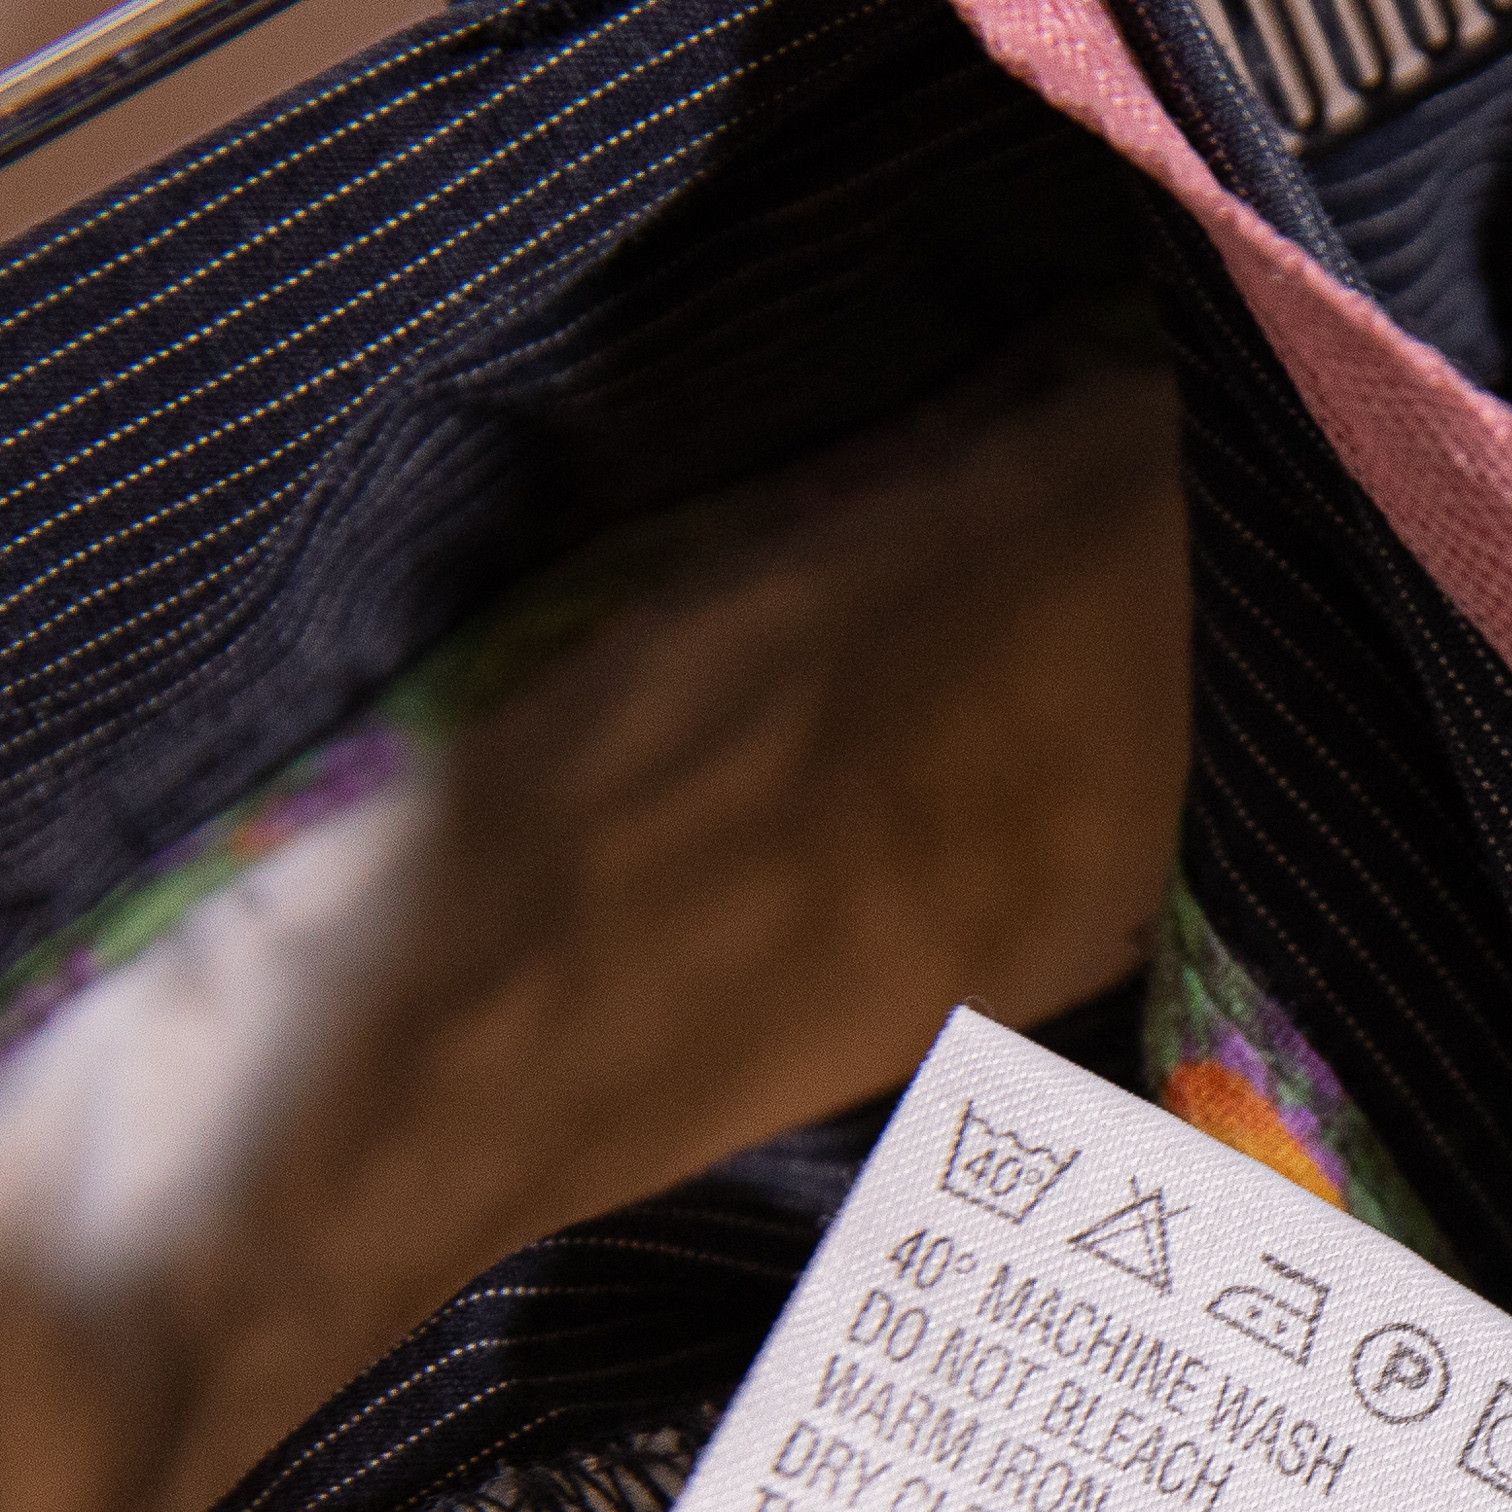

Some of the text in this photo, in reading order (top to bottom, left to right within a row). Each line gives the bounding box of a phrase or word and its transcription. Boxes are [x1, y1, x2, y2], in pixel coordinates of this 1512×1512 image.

[846, 1287, 930, 1363] DO
[931, 1326, 1047, 1410] NOT
[886, 1227, 1354, 1497] 40° MACHINE WASH
[771, 1419, 891, 1508] DRY
[815, 1353, 979, 1472] WARM
